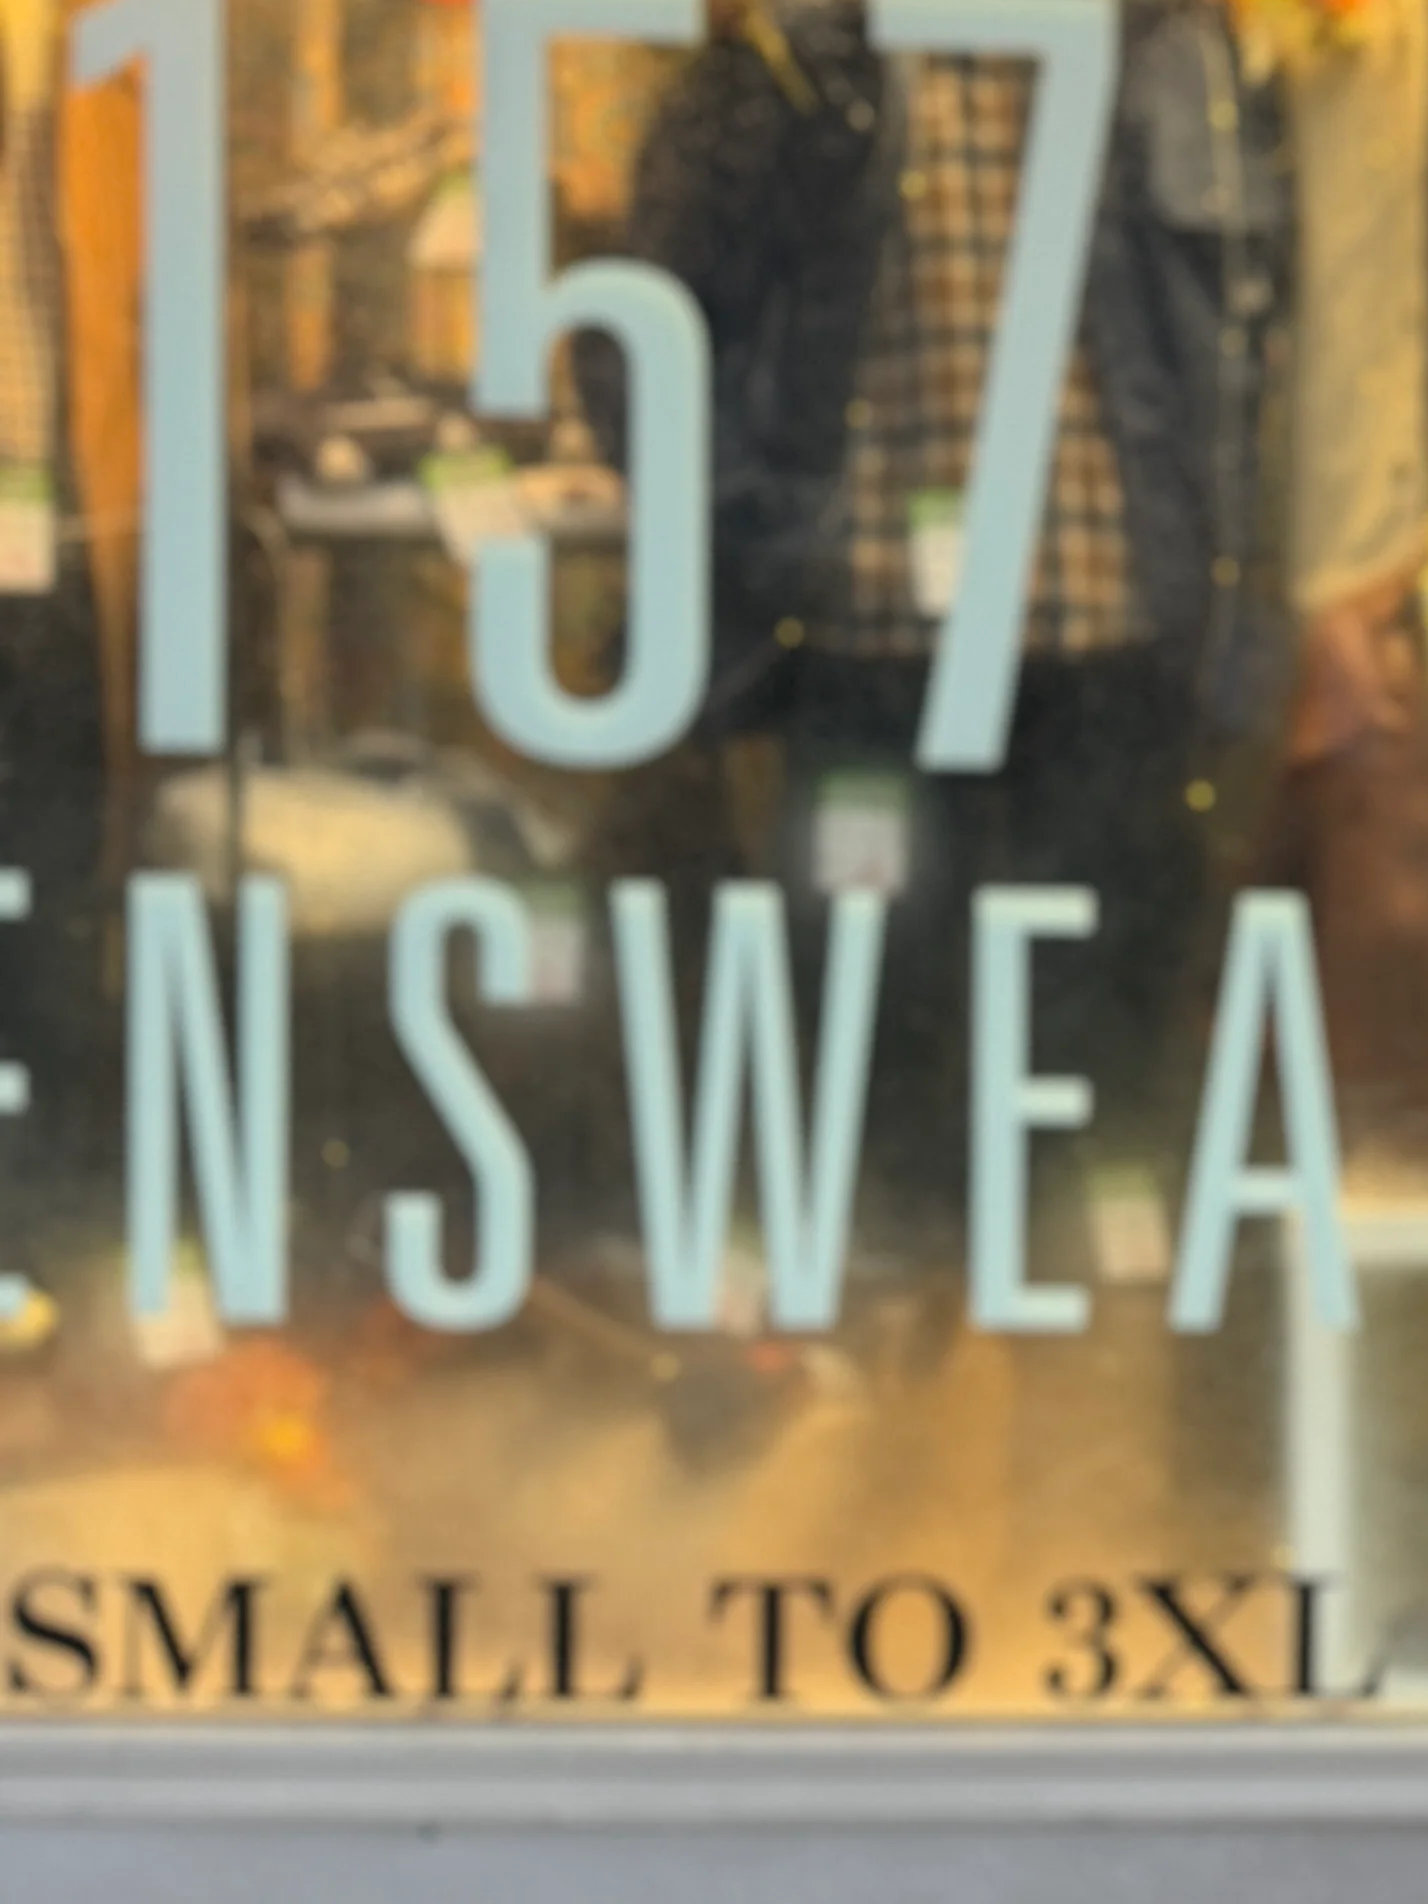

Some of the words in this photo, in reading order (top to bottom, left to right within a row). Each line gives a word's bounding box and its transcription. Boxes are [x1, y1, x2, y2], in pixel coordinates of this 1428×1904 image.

[6, 1564, 645, 1702] SMALL
[708, 1570, 976, 1703] TO
[1044, 1571, 1398, 1704] 3XL
